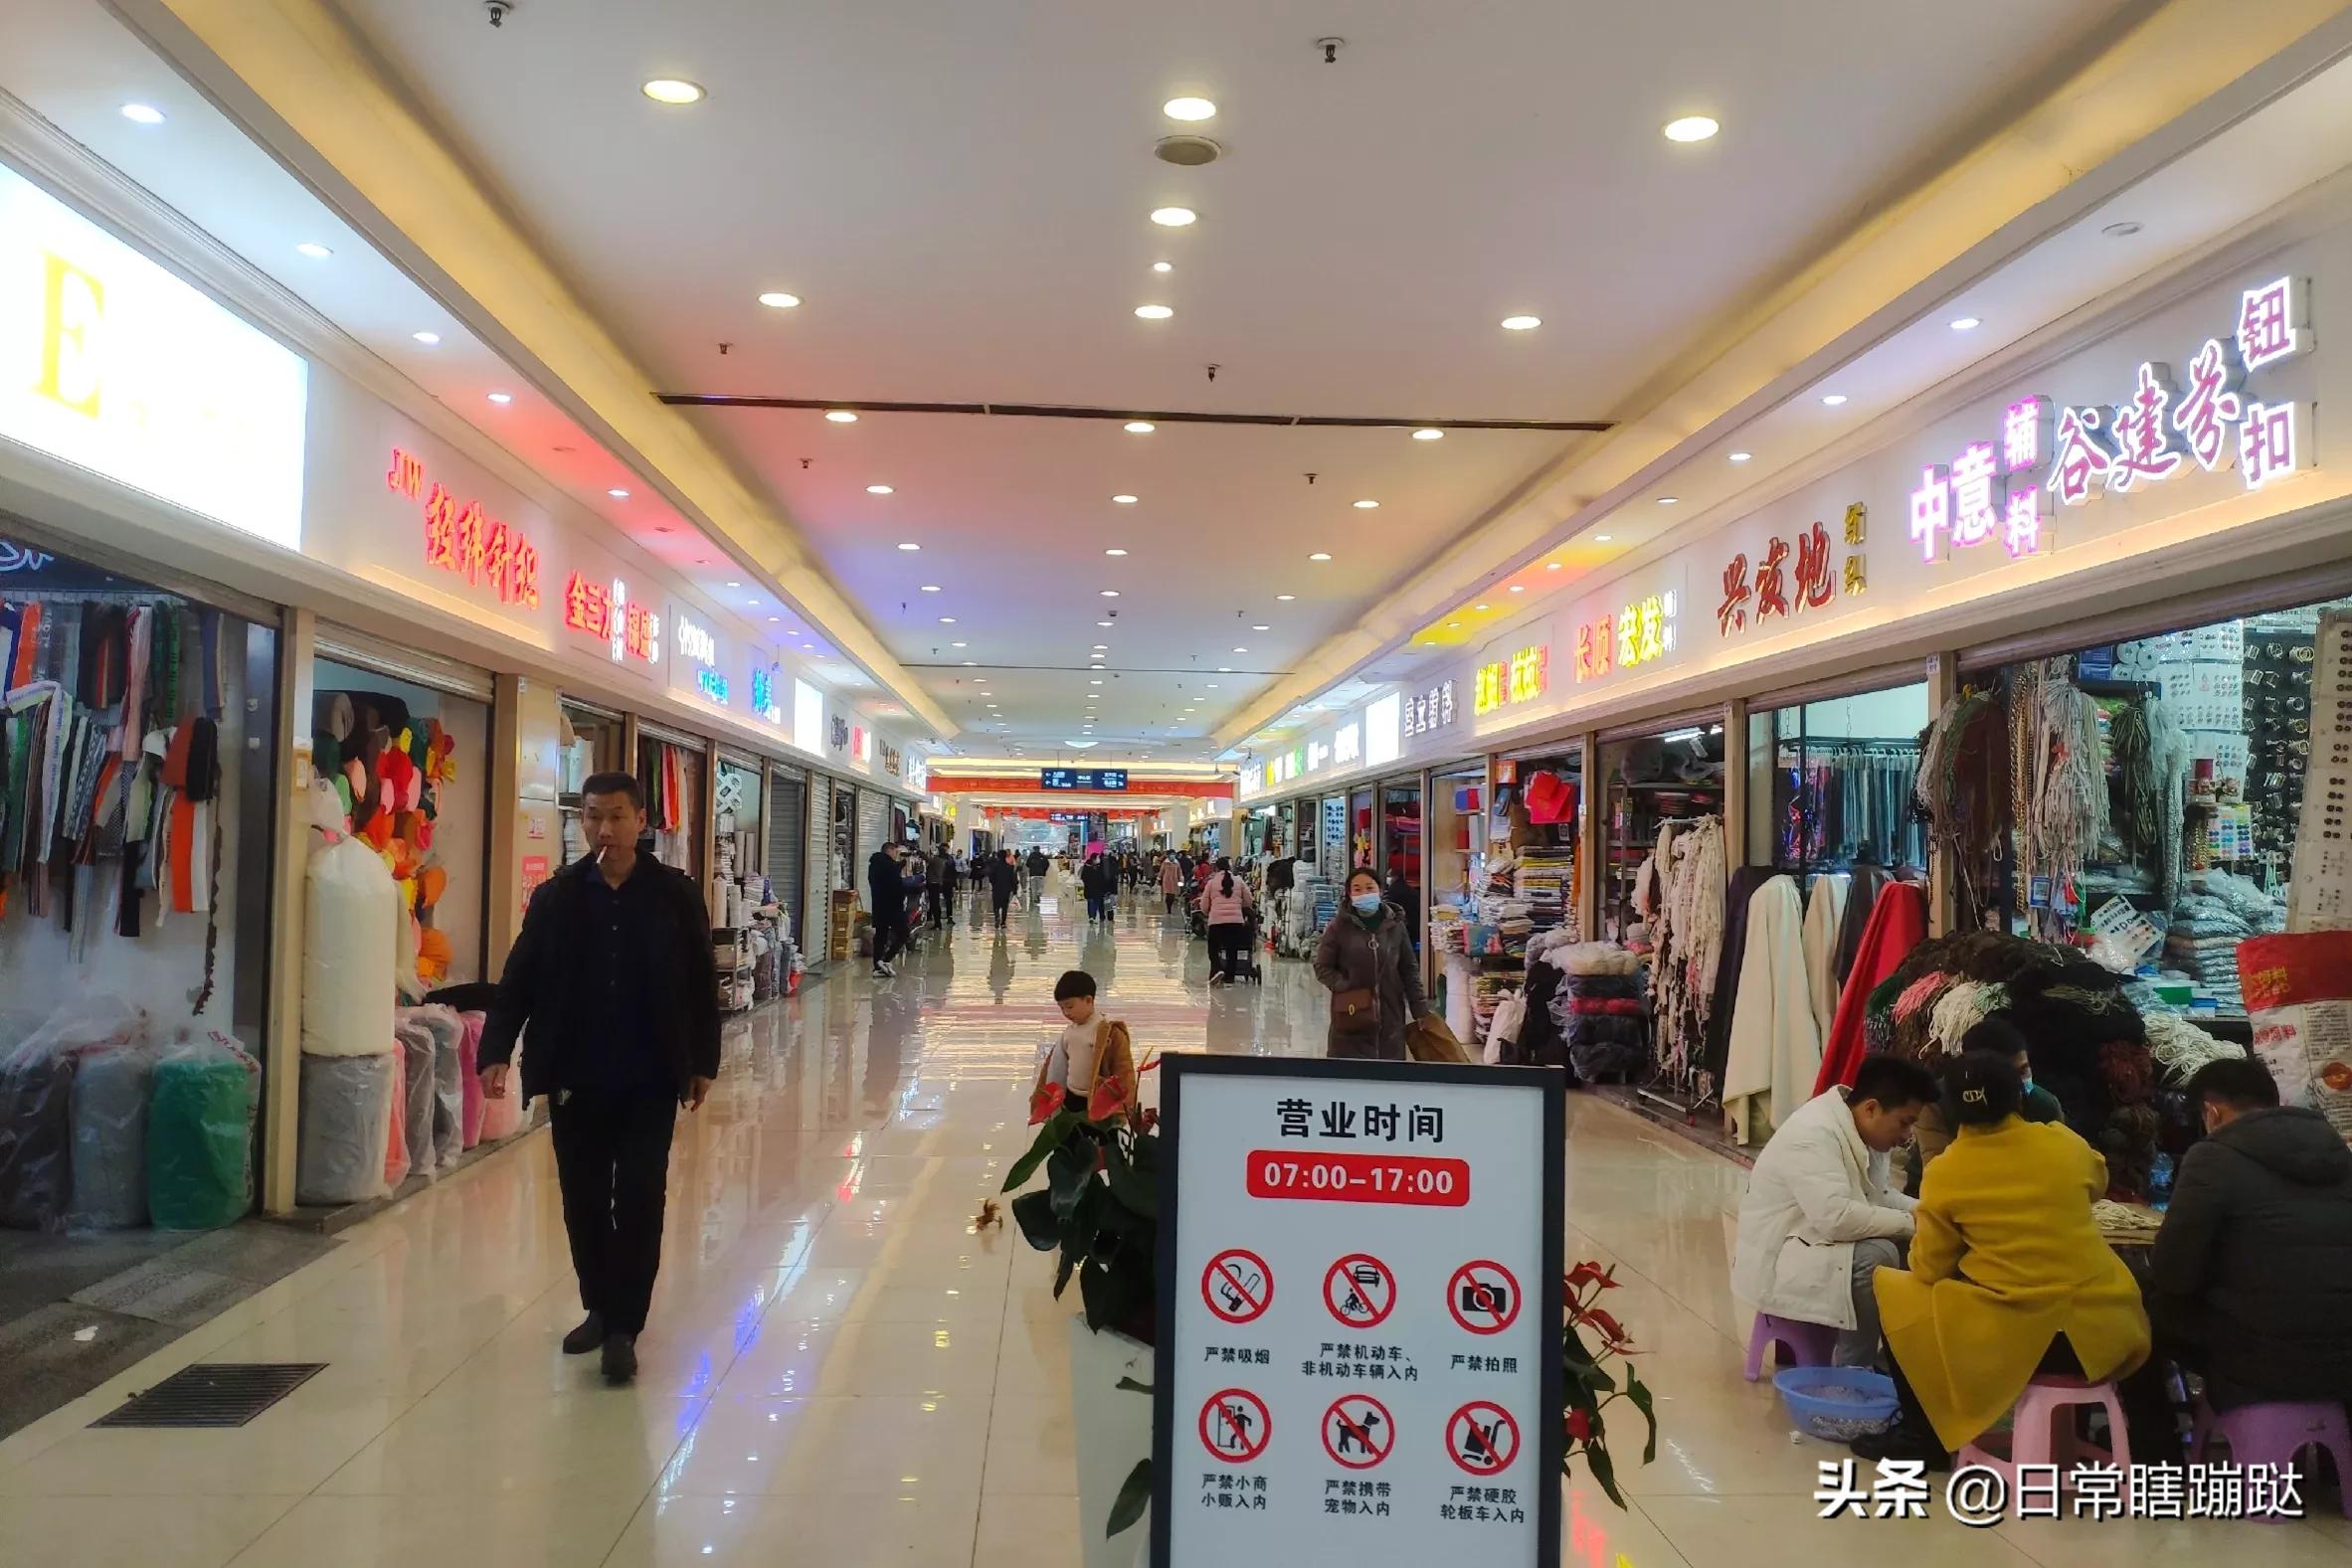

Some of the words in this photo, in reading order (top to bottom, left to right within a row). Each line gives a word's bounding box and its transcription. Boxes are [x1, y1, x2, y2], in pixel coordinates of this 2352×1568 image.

[2240, 274, 2296, 489] 钮扣
[1911, 440, 2002, 564] 中意
[2003, 396, 2044, 559] 辅料
[1276, 1098, 1444, 1143] 营业时间
[1264, 1161, 1454, 1195] 07:00-17:00
[1204, 1346, 1270, 1364] 严禁吸烟
[1320, 1342, 1411, 1362] 严禁机动车、
[1302, 1360, 1418, 1382] 非机动车辆入内
[1450, 1354, 1518, 1373] 严禁拍照
[1201, 1474, 1268, 1492] 严禁小商
[1325, 1480, 1392, 1498] 严禁携带
[1201, 1492, 1267, 1510] 小贩入内
[1450, 1485, 1518, 1504] 严禁硬胶
[1324, 1497, 1391, 1517] 宠物入内
[1440, 1503, 1525, 1524] 轮板车入内
